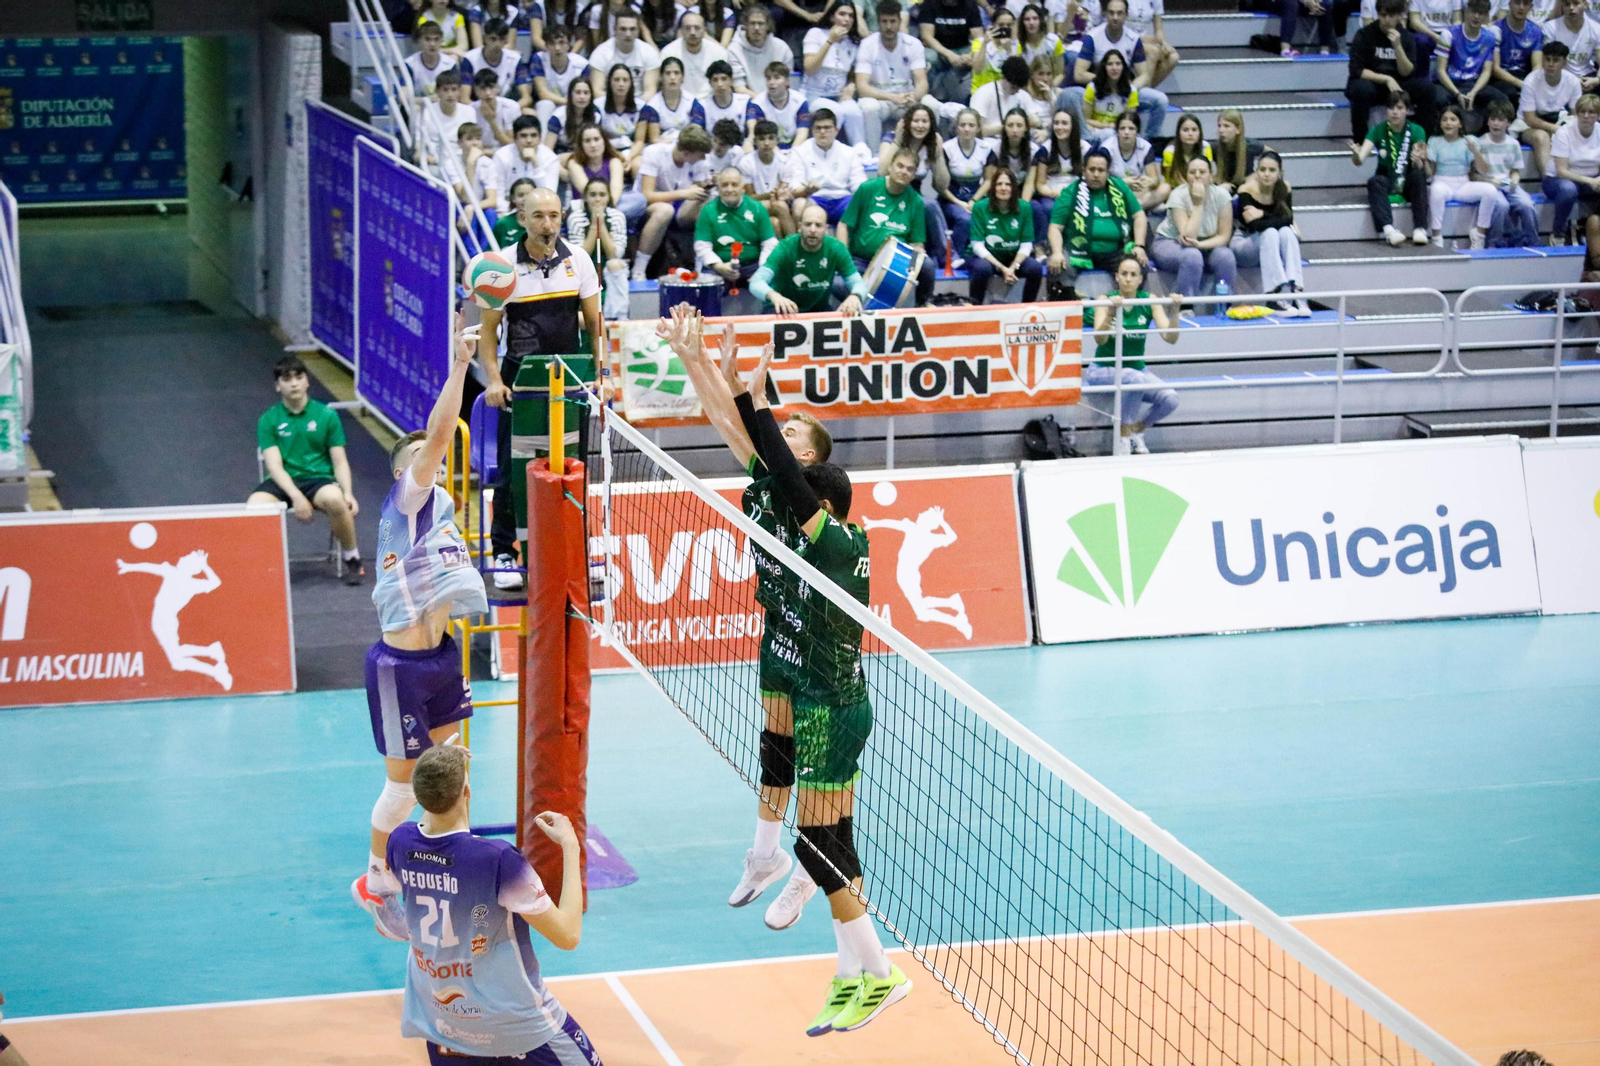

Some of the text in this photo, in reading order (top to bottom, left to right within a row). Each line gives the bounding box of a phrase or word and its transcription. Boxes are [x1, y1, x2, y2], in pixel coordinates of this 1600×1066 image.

[20, 96, 115, 114] DIPUTACIÓN
[23, 113, 113, 129] DE ALMERÍA
[1026, 333, 1056, 343] UNION
[805, 359, 989, 404] UNION
[1212, 504, 1502, 593] Unicaja
[675, 612, 766, 643] VOLEIBO
[15, 651, 144, 682] MASCULINA
[413, 851, 447, 866] ALJOMAR
[401, 868, 459, 895] PEQUEÑO
[415, 895, 460, 949] 21
